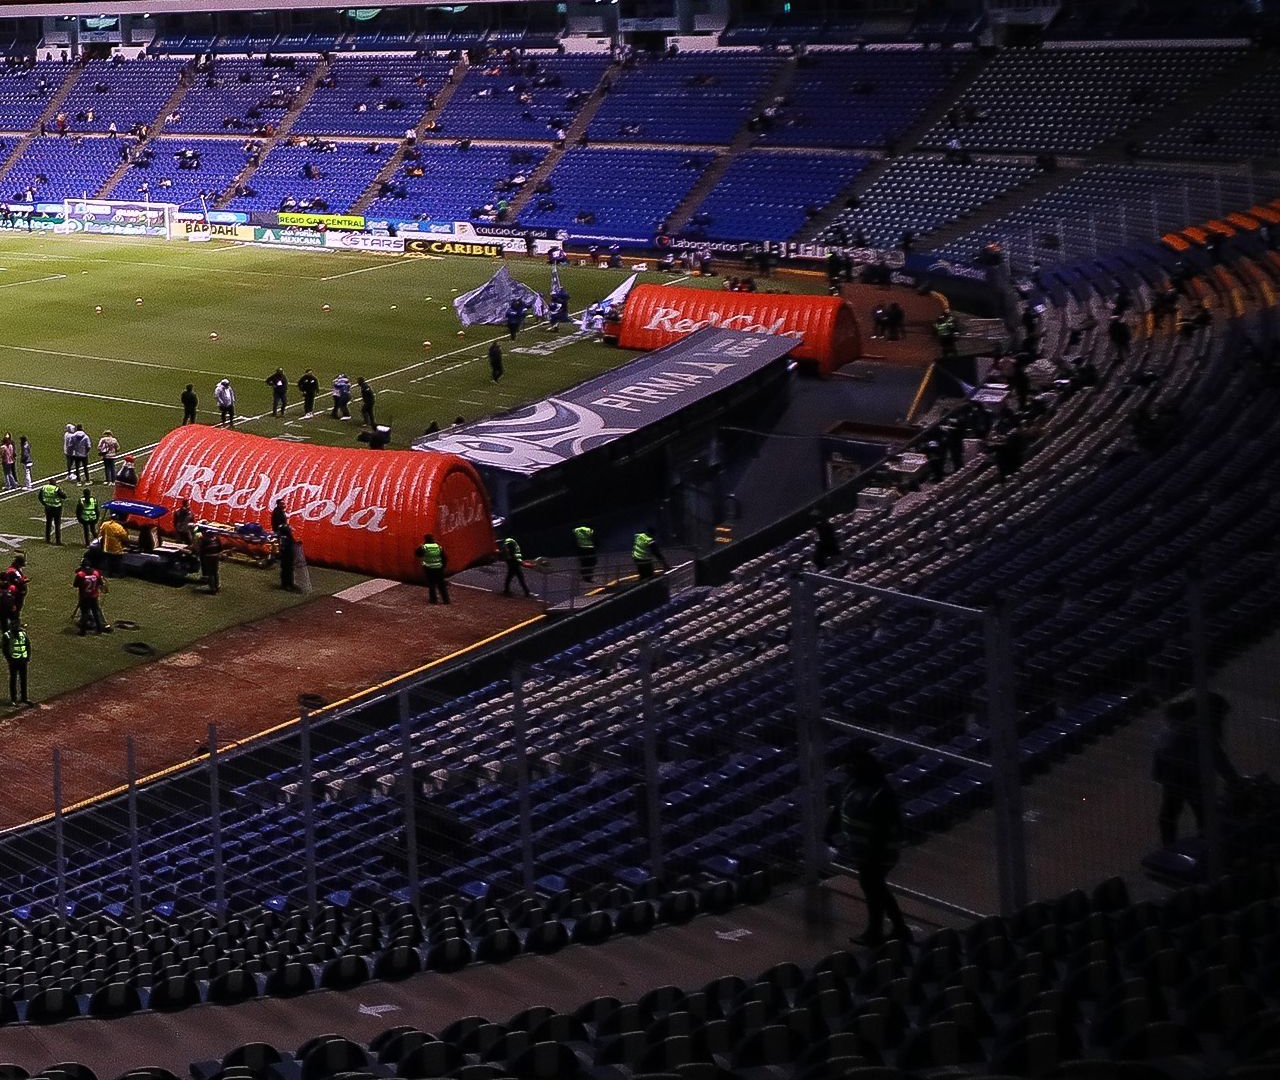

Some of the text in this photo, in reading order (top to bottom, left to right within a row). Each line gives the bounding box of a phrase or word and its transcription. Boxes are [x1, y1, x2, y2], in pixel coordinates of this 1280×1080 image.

[326, 219, 364, 227] CENTRAL
[350, 237, 403, 248] STARS
[591, 371, 713, 412] PIRMA
